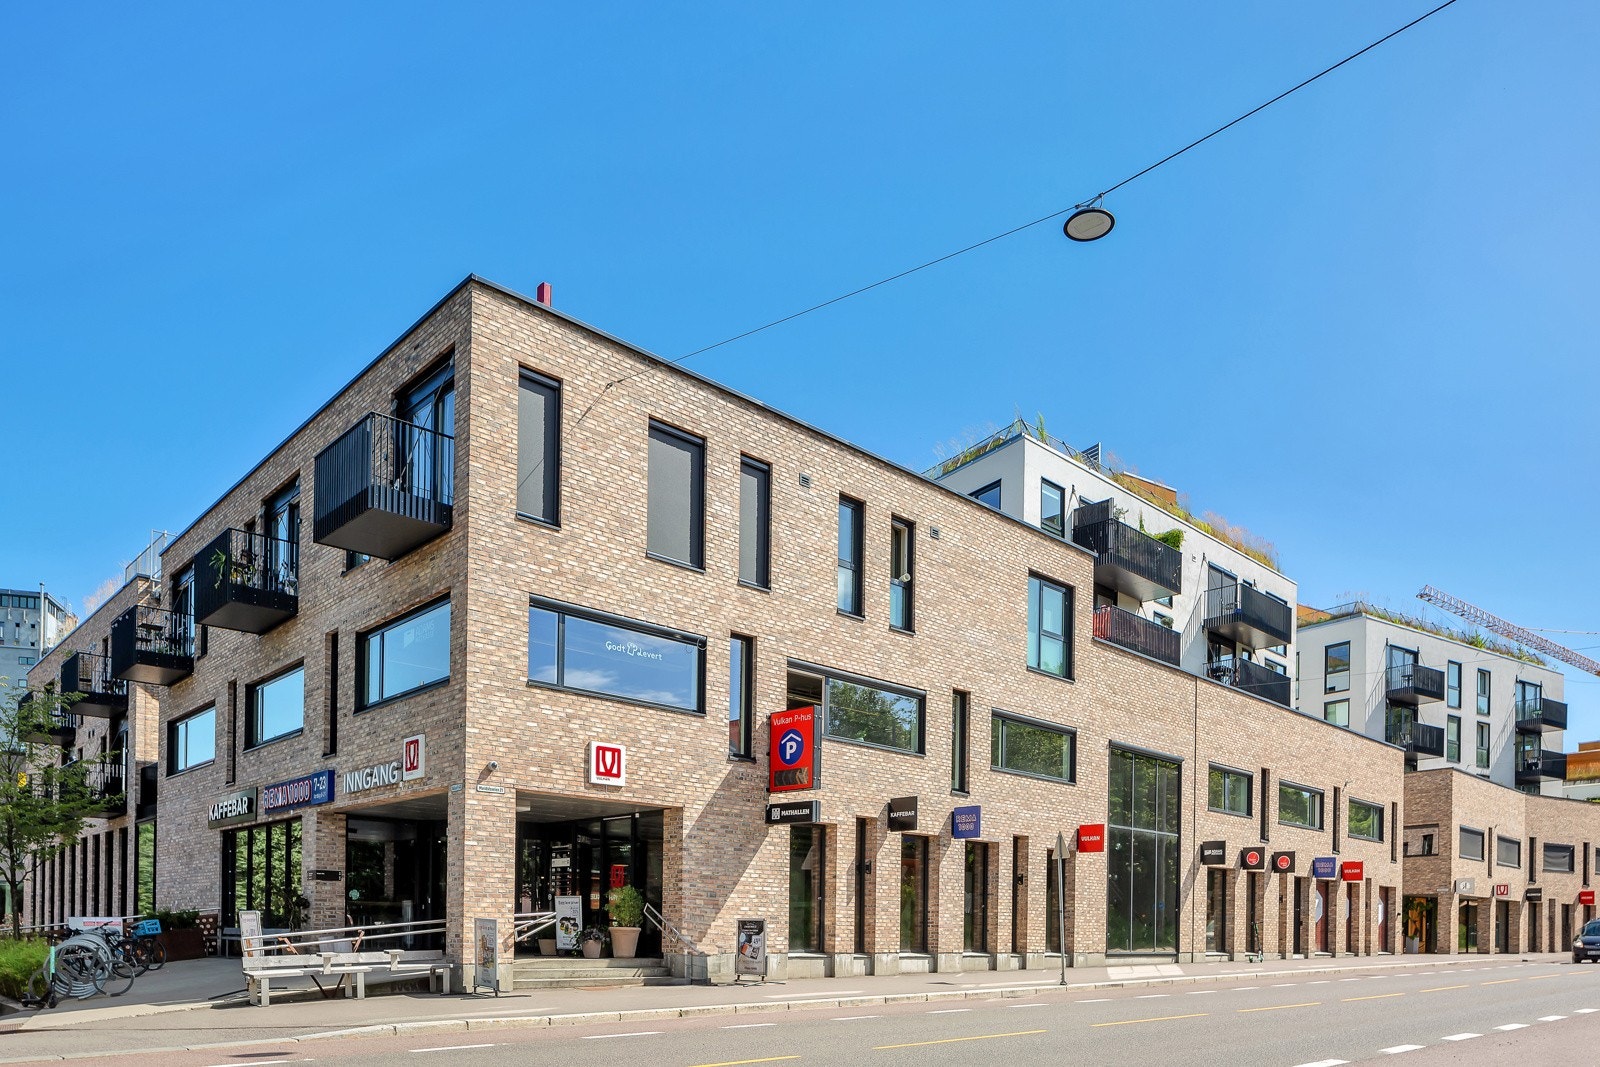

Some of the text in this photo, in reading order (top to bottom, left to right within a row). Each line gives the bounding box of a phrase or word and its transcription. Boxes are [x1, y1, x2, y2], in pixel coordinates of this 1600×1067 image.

[605, 641, 626, 653] Godt
[773, 713, 812, 726] Vulkan P-hus
[785, 741, 797, 759] P
[343, 761, 398, 794] INNGANG
[313, 776, 326, 792] 7-23
[209, 796, 248, 821] KAFFEBAR
[781, 808, 810, 817] MATHALLEN
[890, 810, 915, 818] KAFFEBAR
[955, 814, 977, 823] REMA
[957, 823, 975, 831] 1000
